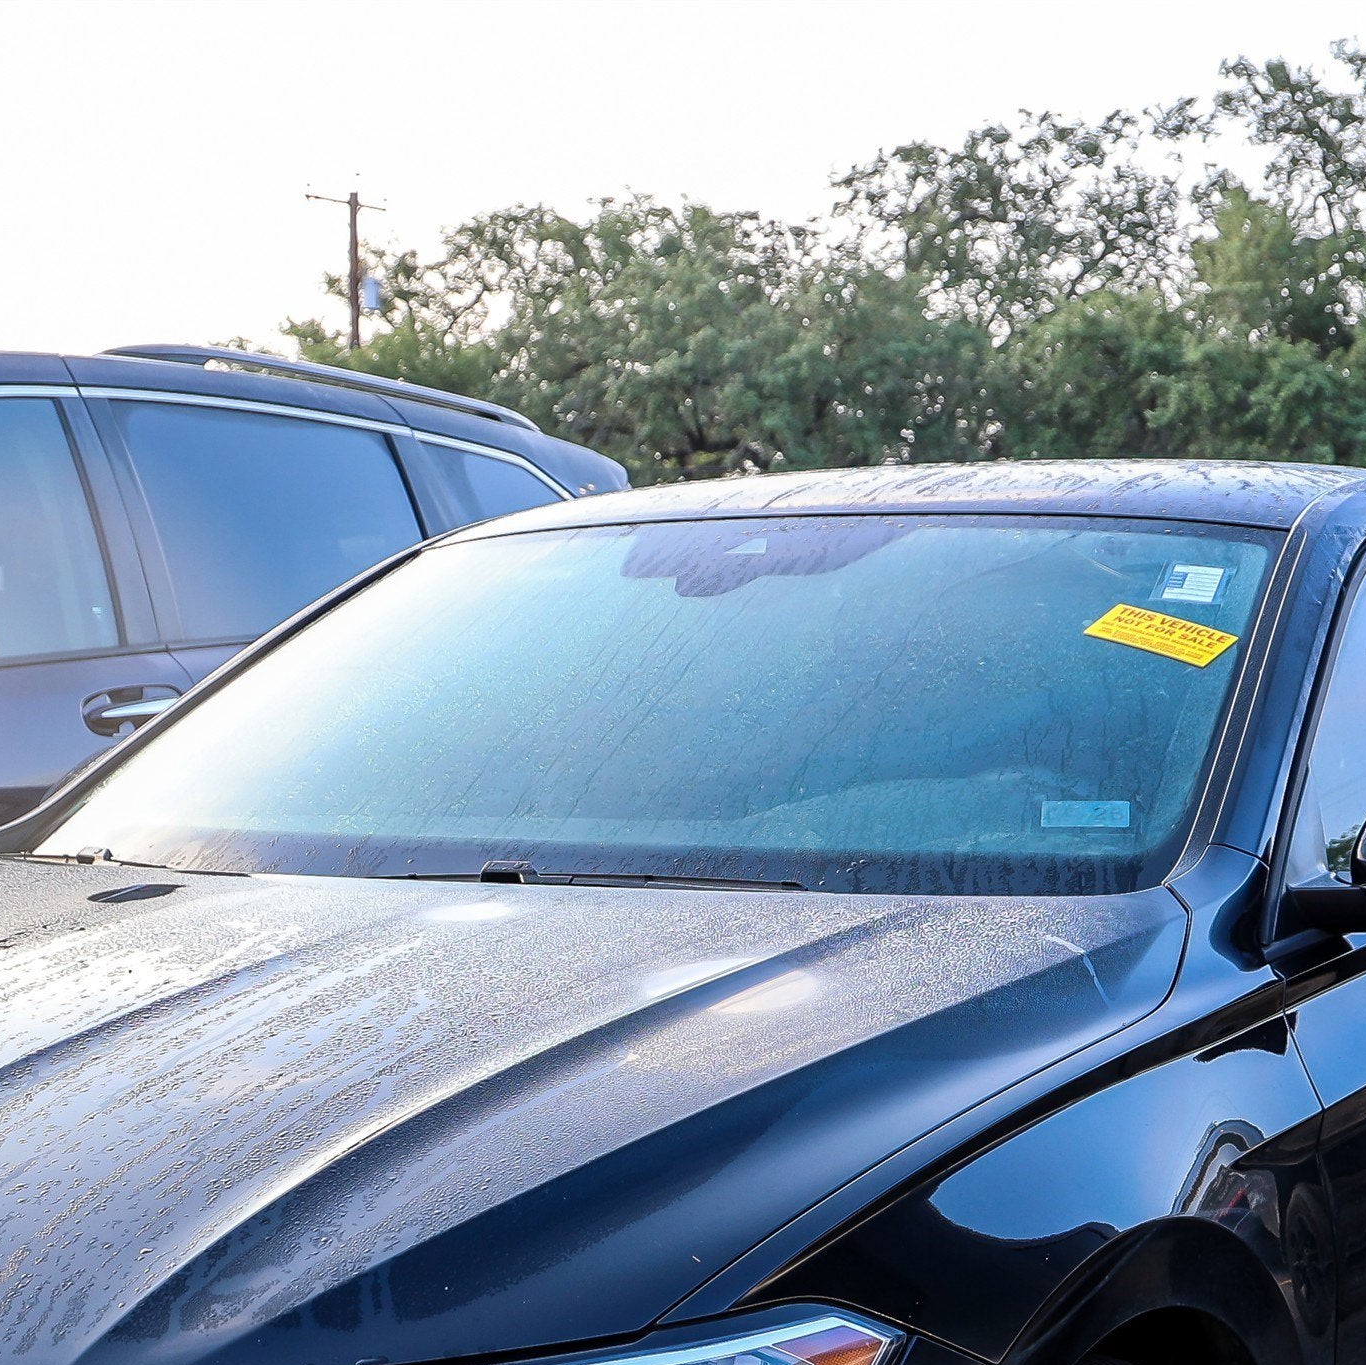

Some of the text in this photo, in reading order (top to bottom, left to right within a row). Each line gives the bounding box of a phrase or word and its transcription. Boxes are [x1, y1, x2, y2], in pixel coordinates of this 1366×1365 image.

[1114, 616, 1217, 649] NOT FOR SALE
[1120, 607, 1156, 622] THIS
[1159, 617, 1231, 644] VEHICLE
